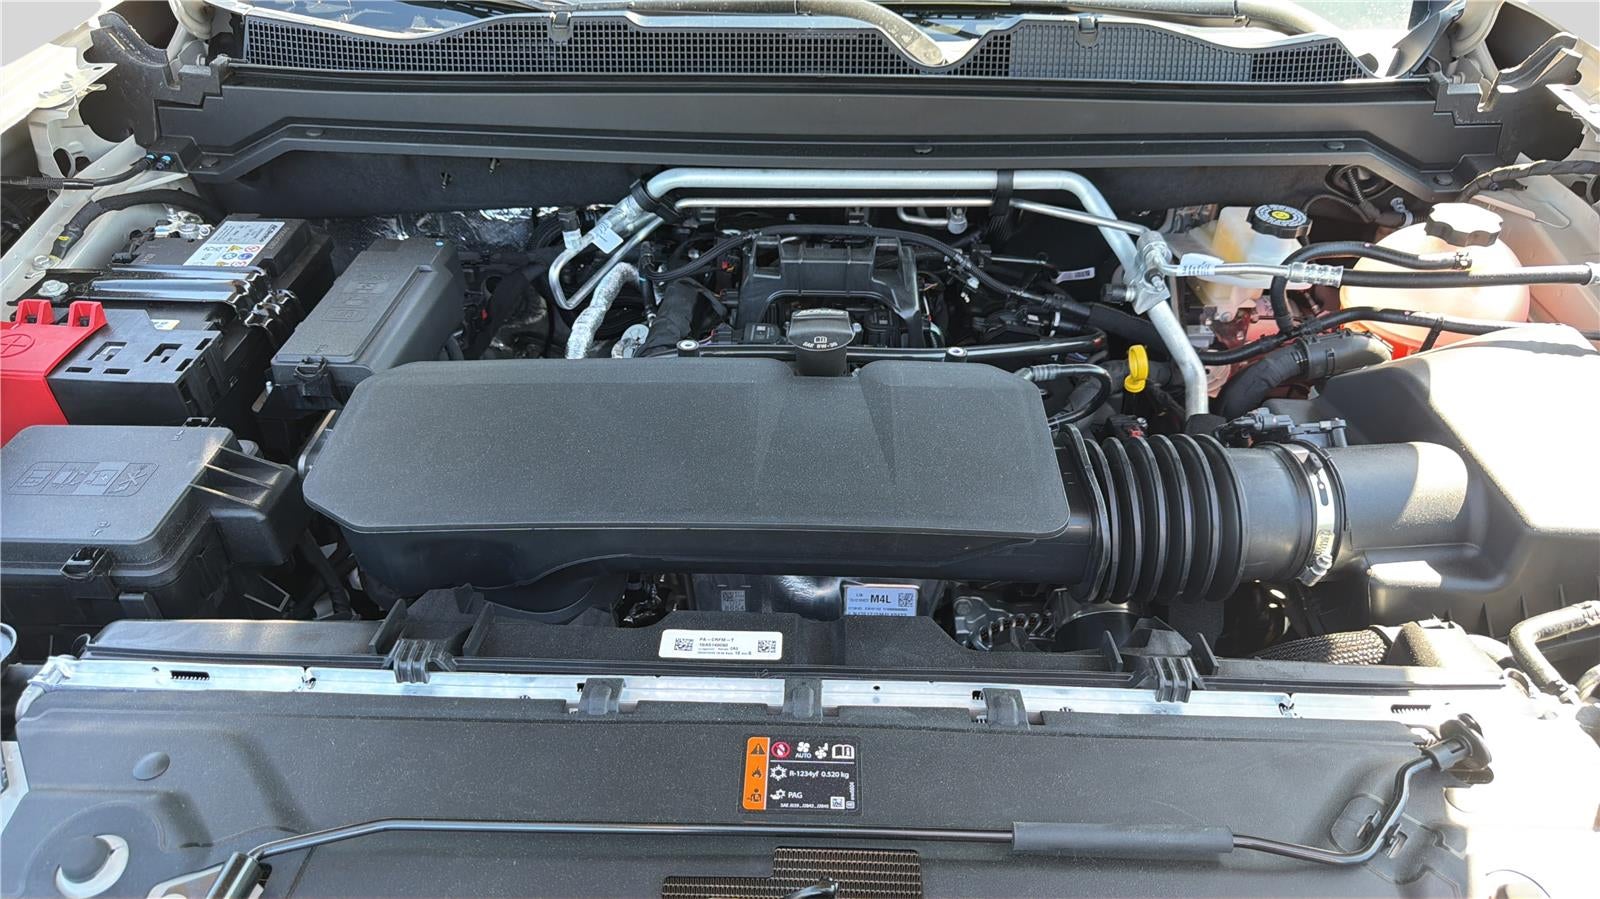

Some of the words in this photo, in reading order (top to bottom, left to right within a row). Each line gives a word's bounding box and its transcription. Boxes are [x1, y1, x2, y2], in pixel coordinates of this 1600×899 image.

[870, 594, 891, 603] M4L
[789, 770, 819, 780] R-1234yf
[840, 771, 850, 780] kg
[788, 791, 803, 799] PAG
